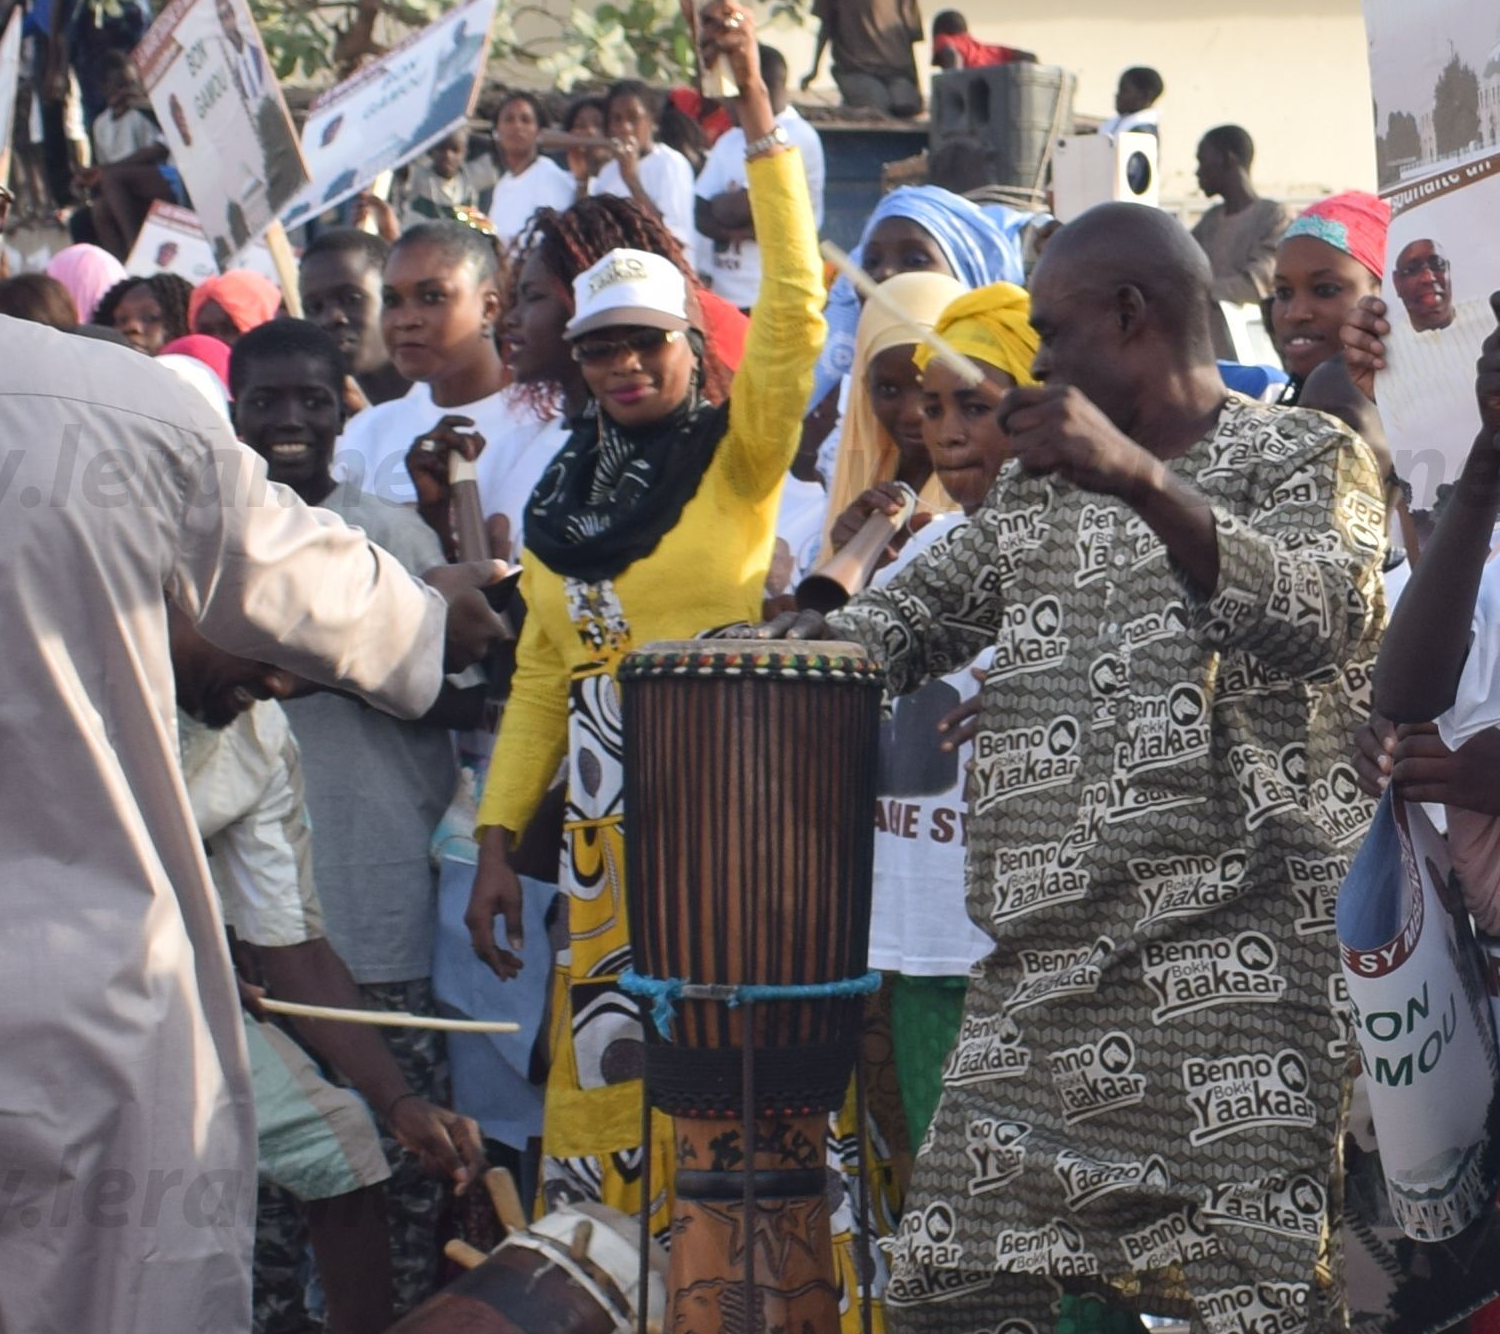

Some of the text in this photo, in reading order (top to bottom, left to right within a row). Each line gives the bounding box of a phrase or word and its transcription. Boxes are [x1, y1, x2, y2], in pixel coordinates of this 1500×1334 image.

[980, 728, 1045, 760] Benno
[976, 751, 1079, 799] Yaakaar
[1145, 938, 1231, 967] Benno
[1150, 961, 1285, 1008] Yaakaar
[1171, 961, 1211, 978] Bokk
[1187, 1058, 1272, 1087] Benno
[1193, 1080, 1316, 1128] Yaakaar
[1213, 1080, 1252, 1101] Bokk
